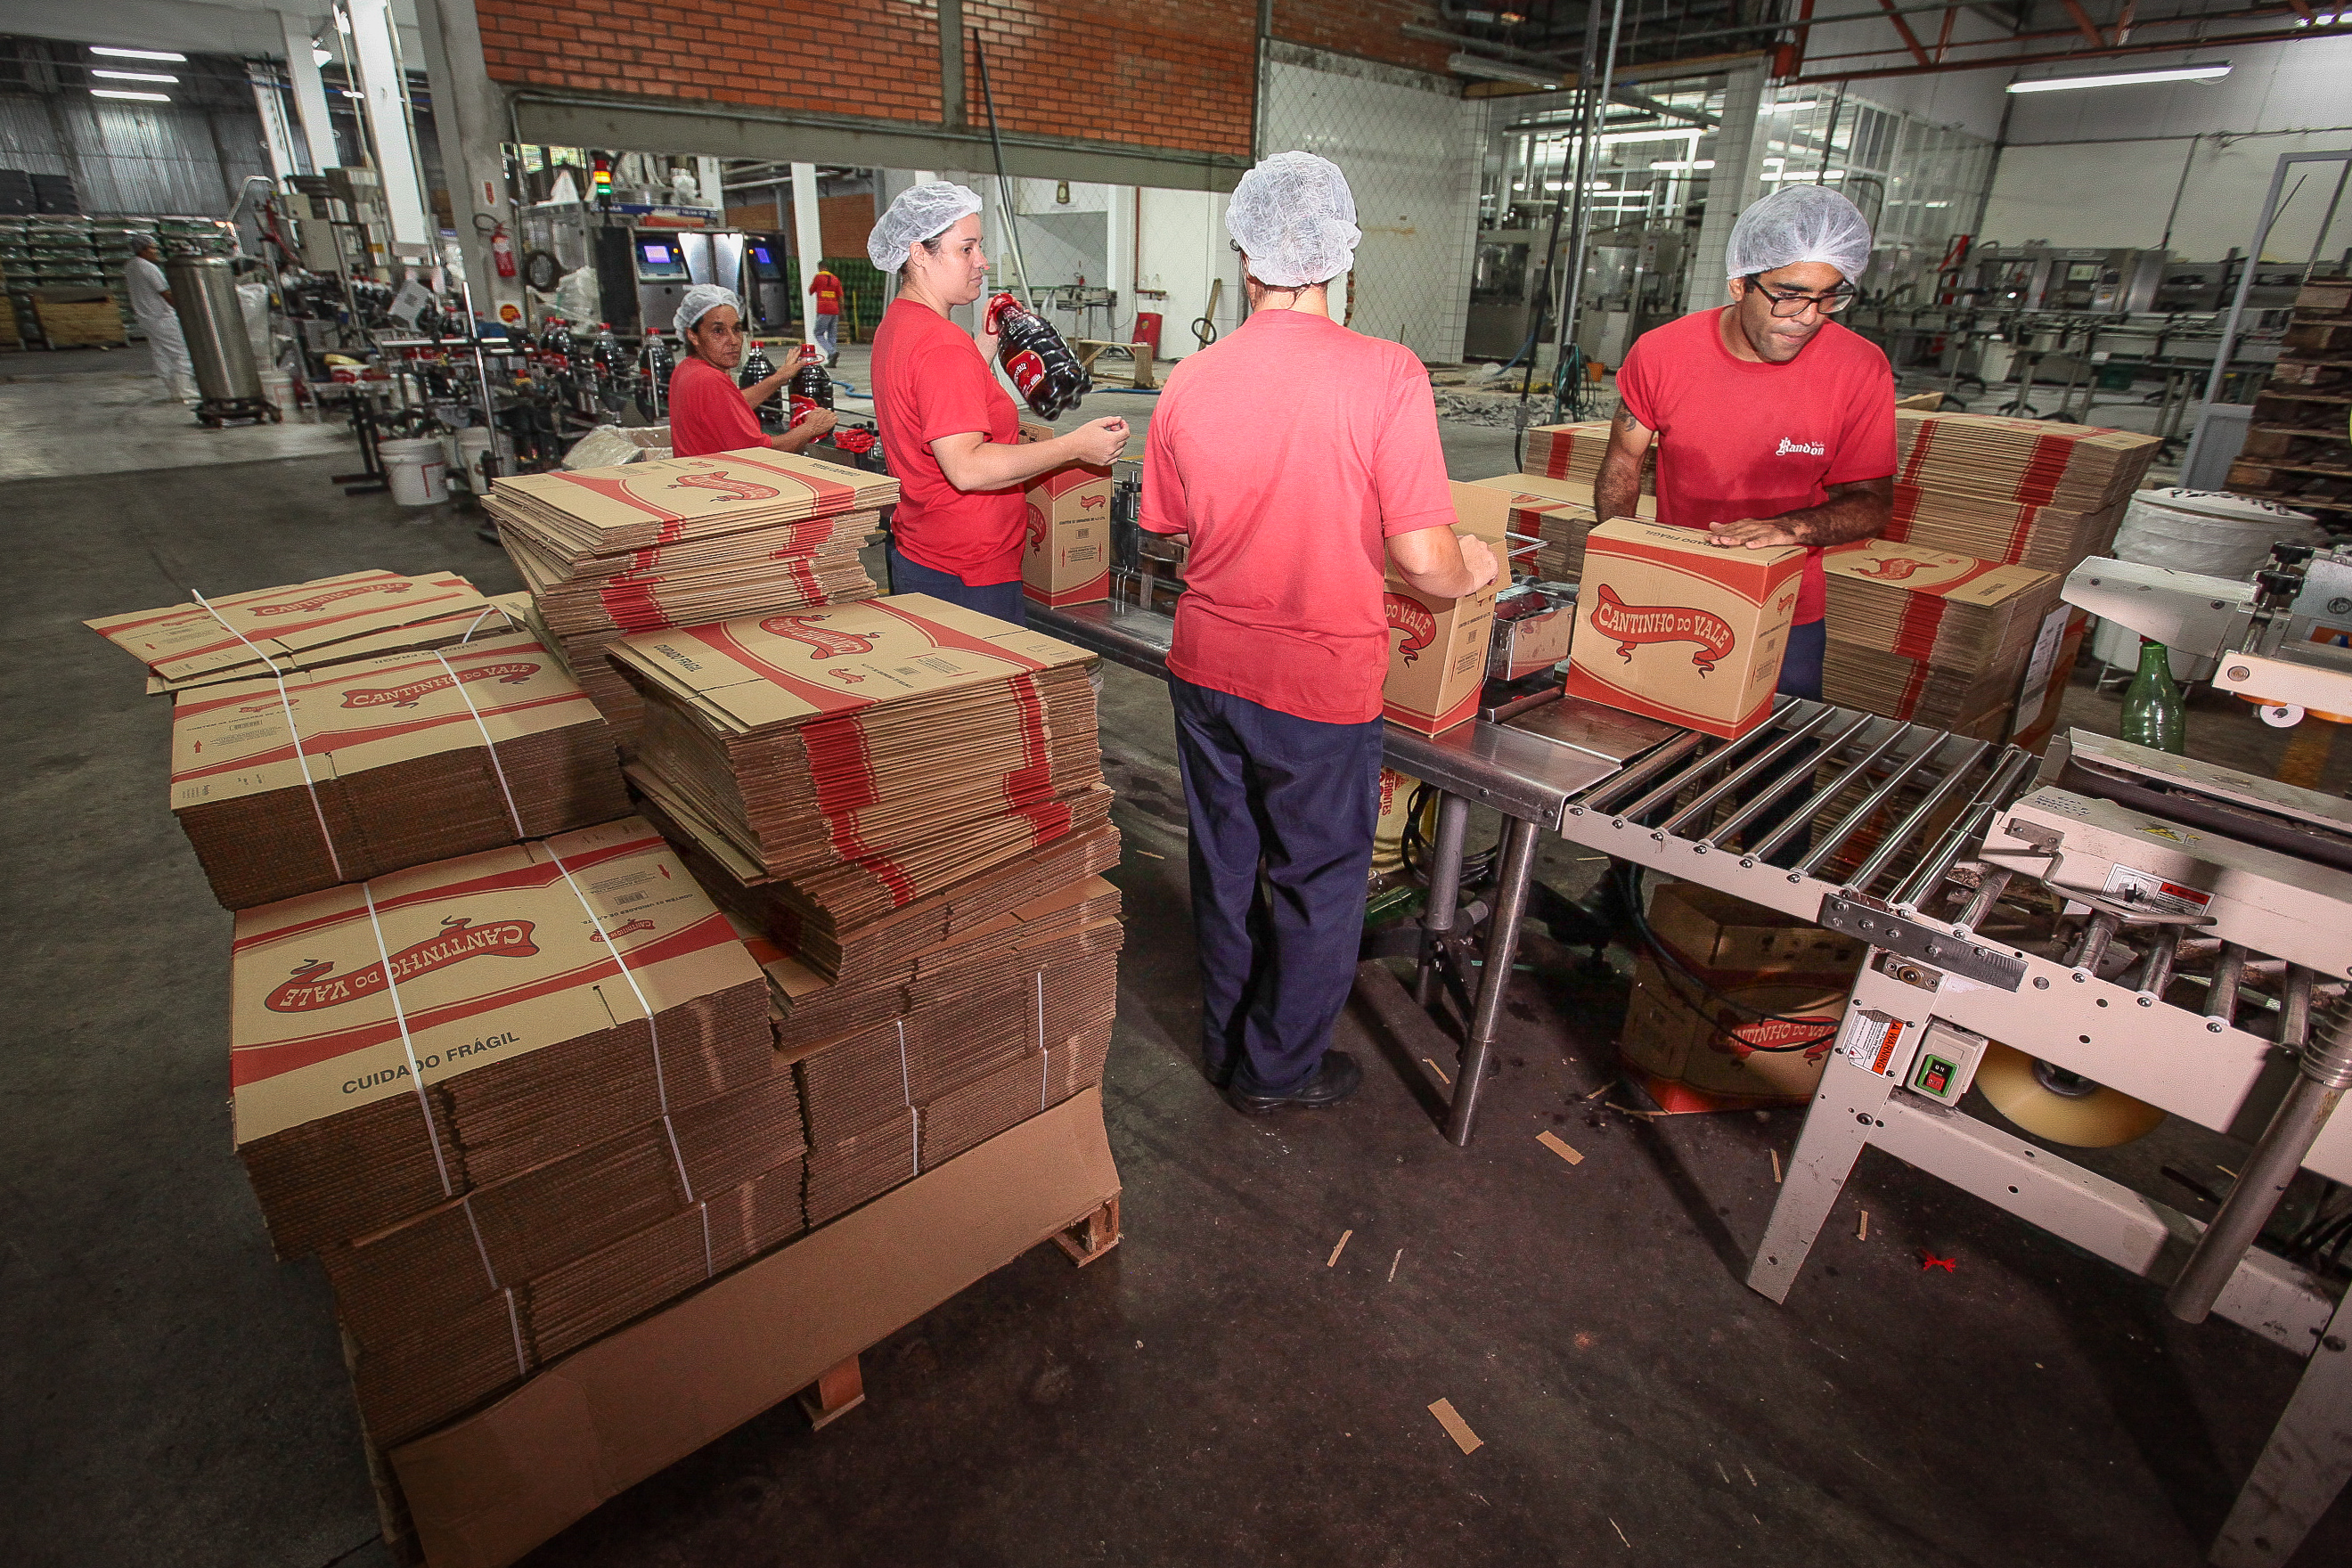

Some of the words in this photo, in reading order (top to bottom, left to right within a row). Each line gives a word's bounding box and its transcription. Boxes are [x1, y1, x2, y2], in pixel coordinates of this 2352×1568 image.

[1776, 437, 1825, 456] Randon
[1386, 604, 1399, 617] DO
[1401, 602, 1432, 638] VALE
[1599, 602, 1675, 634] CANTINHO
[1677, 617, 1692, 632] DO
[1694, 615, 1731, 649] VALE
[353, 674, 461, 706] CANTINHO
[464, 671, 482, 680] DO
[483, 664, 531, 677] VALE
[1382, 767, 1396, 816] GERANTES
[617, 921, 651, 935] CANTINHO
[391, 925, 523, 978] CANTINHO
[280, 979, 351, 1007] VALE
[355, 971, 380, 988] DO
[1793, 1025, 1808, 1036] DO
[342, 1055, 441, 1094] CUIDADO
[446, 1032, 521, 1062] FRÁGIL
[1876, 1032, 1898, 1069] WARNING
[1935, 1064, 1945, 1073] ON
